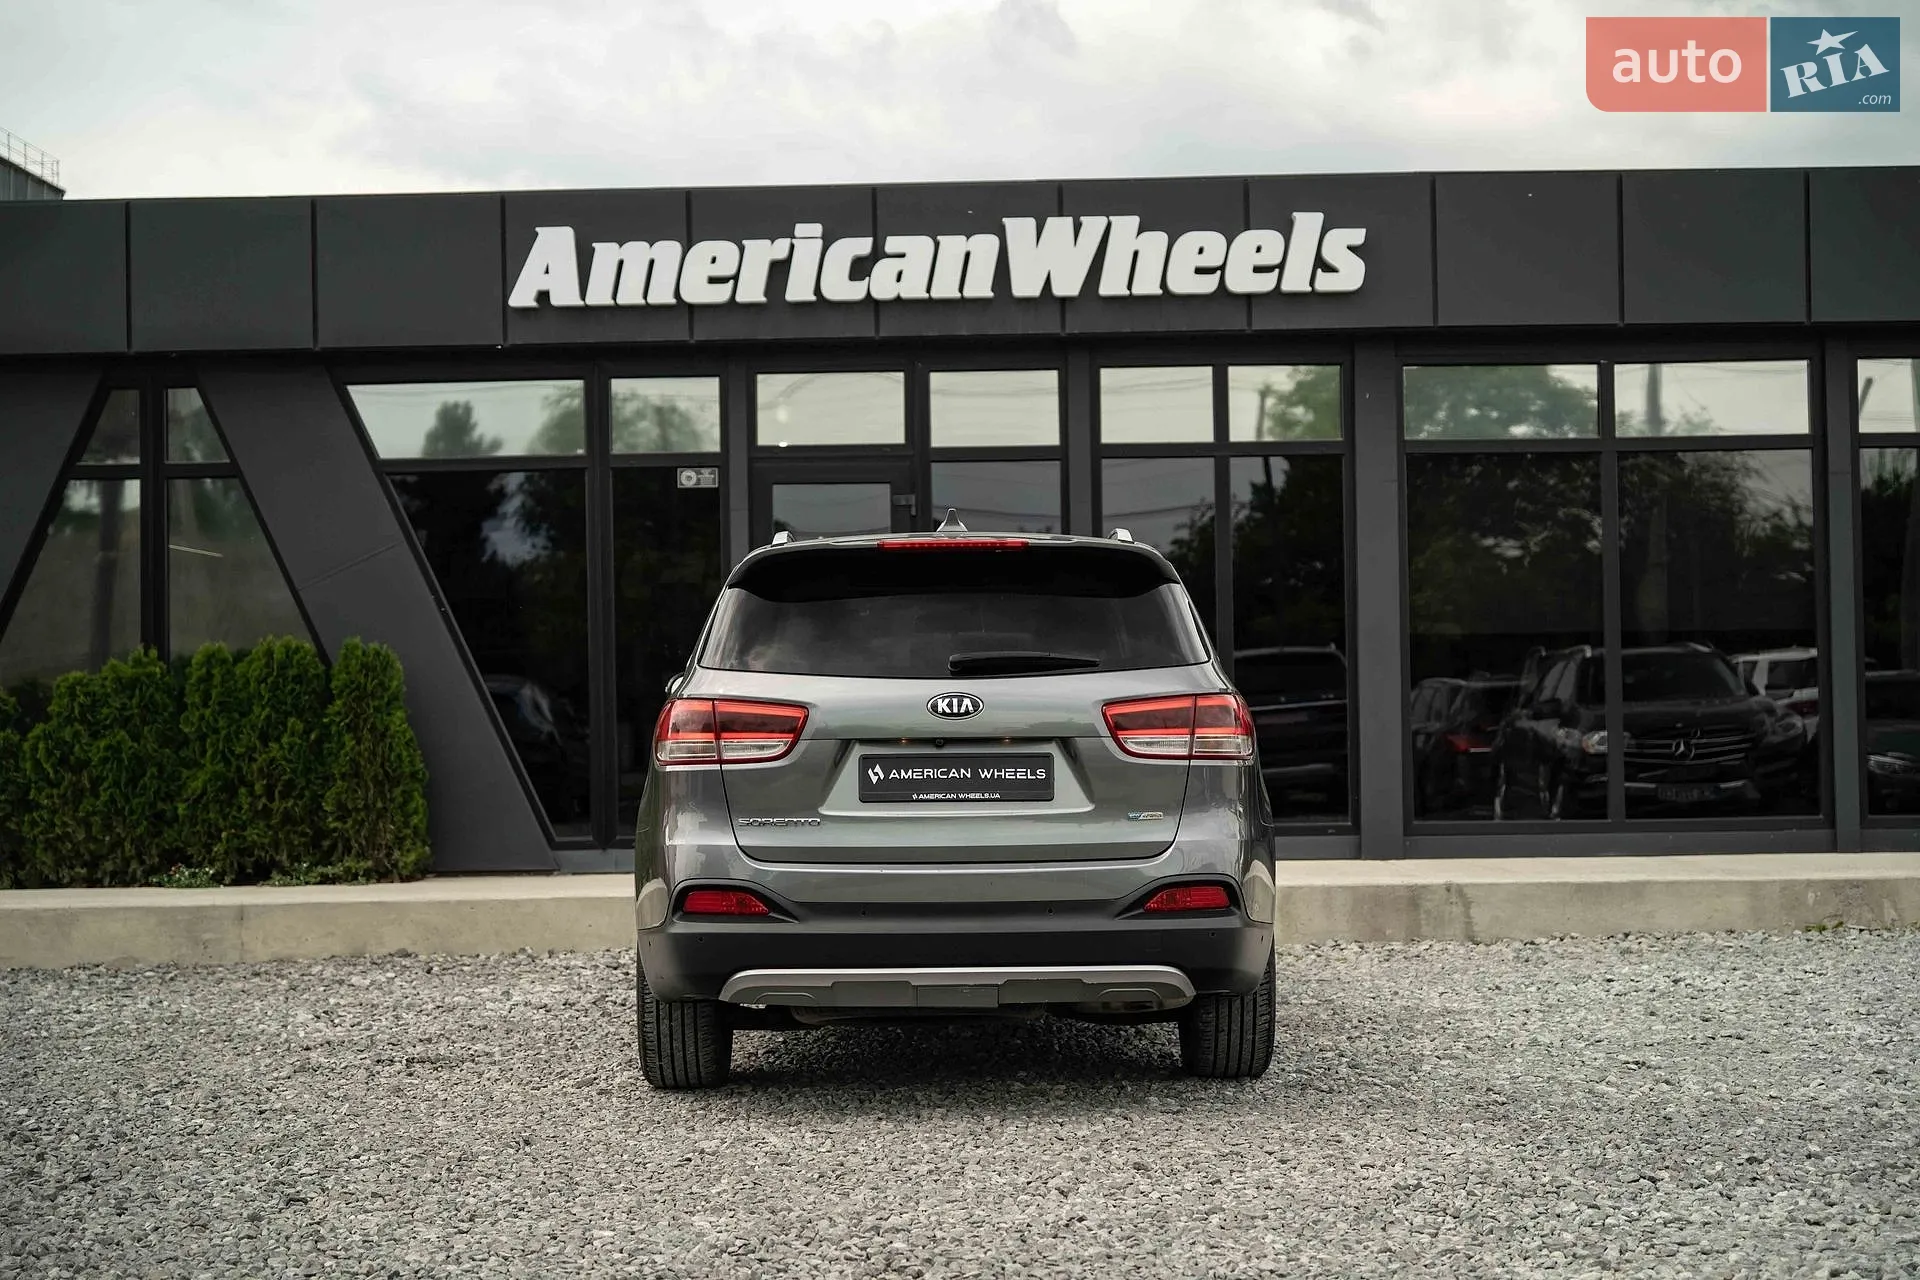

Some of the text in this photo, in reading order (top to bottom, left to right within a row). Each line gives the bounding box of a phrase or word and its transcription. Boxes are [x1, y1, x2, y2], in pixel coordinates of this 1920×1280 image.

[507, 211, 1367, 308] AmericanWheels
[937, 697, 974, 714] KIA
[888, 768, 1046, 780] AMERICAN WHEELS
[738, 817, 821, 828] SORENTO
